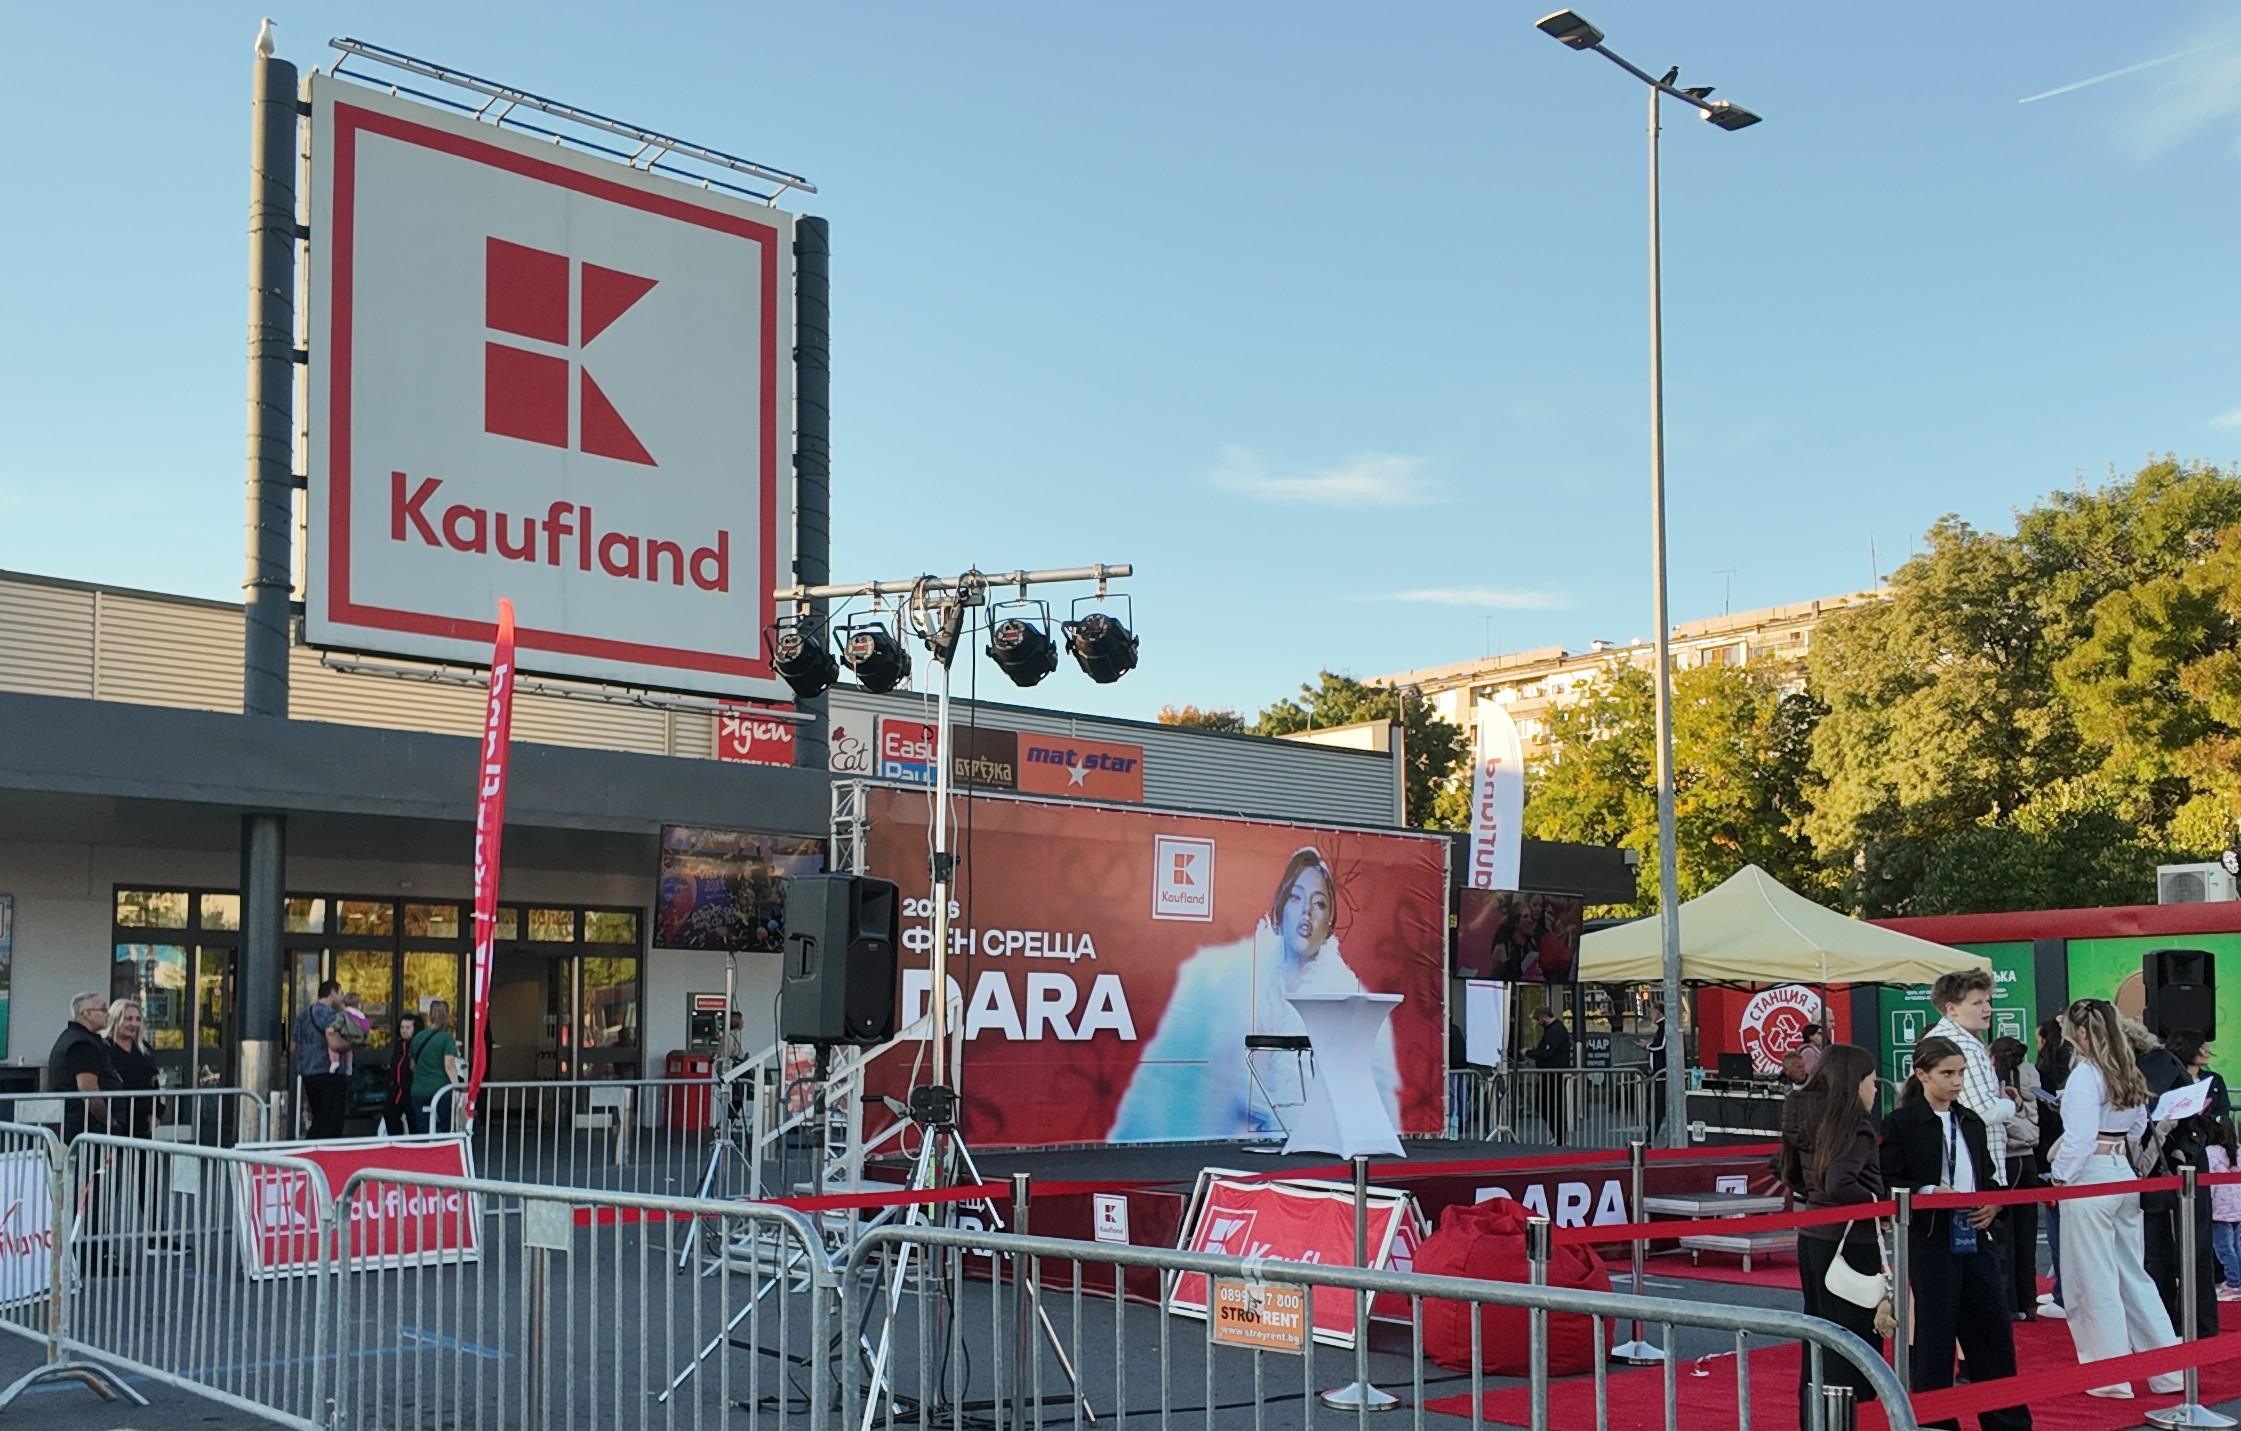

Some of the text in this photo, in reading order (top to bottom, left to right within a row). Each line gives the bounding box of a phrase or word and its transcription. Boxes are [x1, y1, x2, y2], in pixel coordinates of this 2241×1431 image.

[391, 470, 730, 593] Kaufland
[831, 737, 869, 772] Eat
[1027, 747, 1137, 773] mat star
[902, 898, 961, 919] 206
[1161, 890, 1205, 905] Kaufland
[982, 929, 1097, 964] СРЕЩА
[1749, 989, 1809, 1022] СТАНЦИЯ
[1220, 1287, 1249, 1304] 0899
[1277, 1294, 1299, 1309] 800
